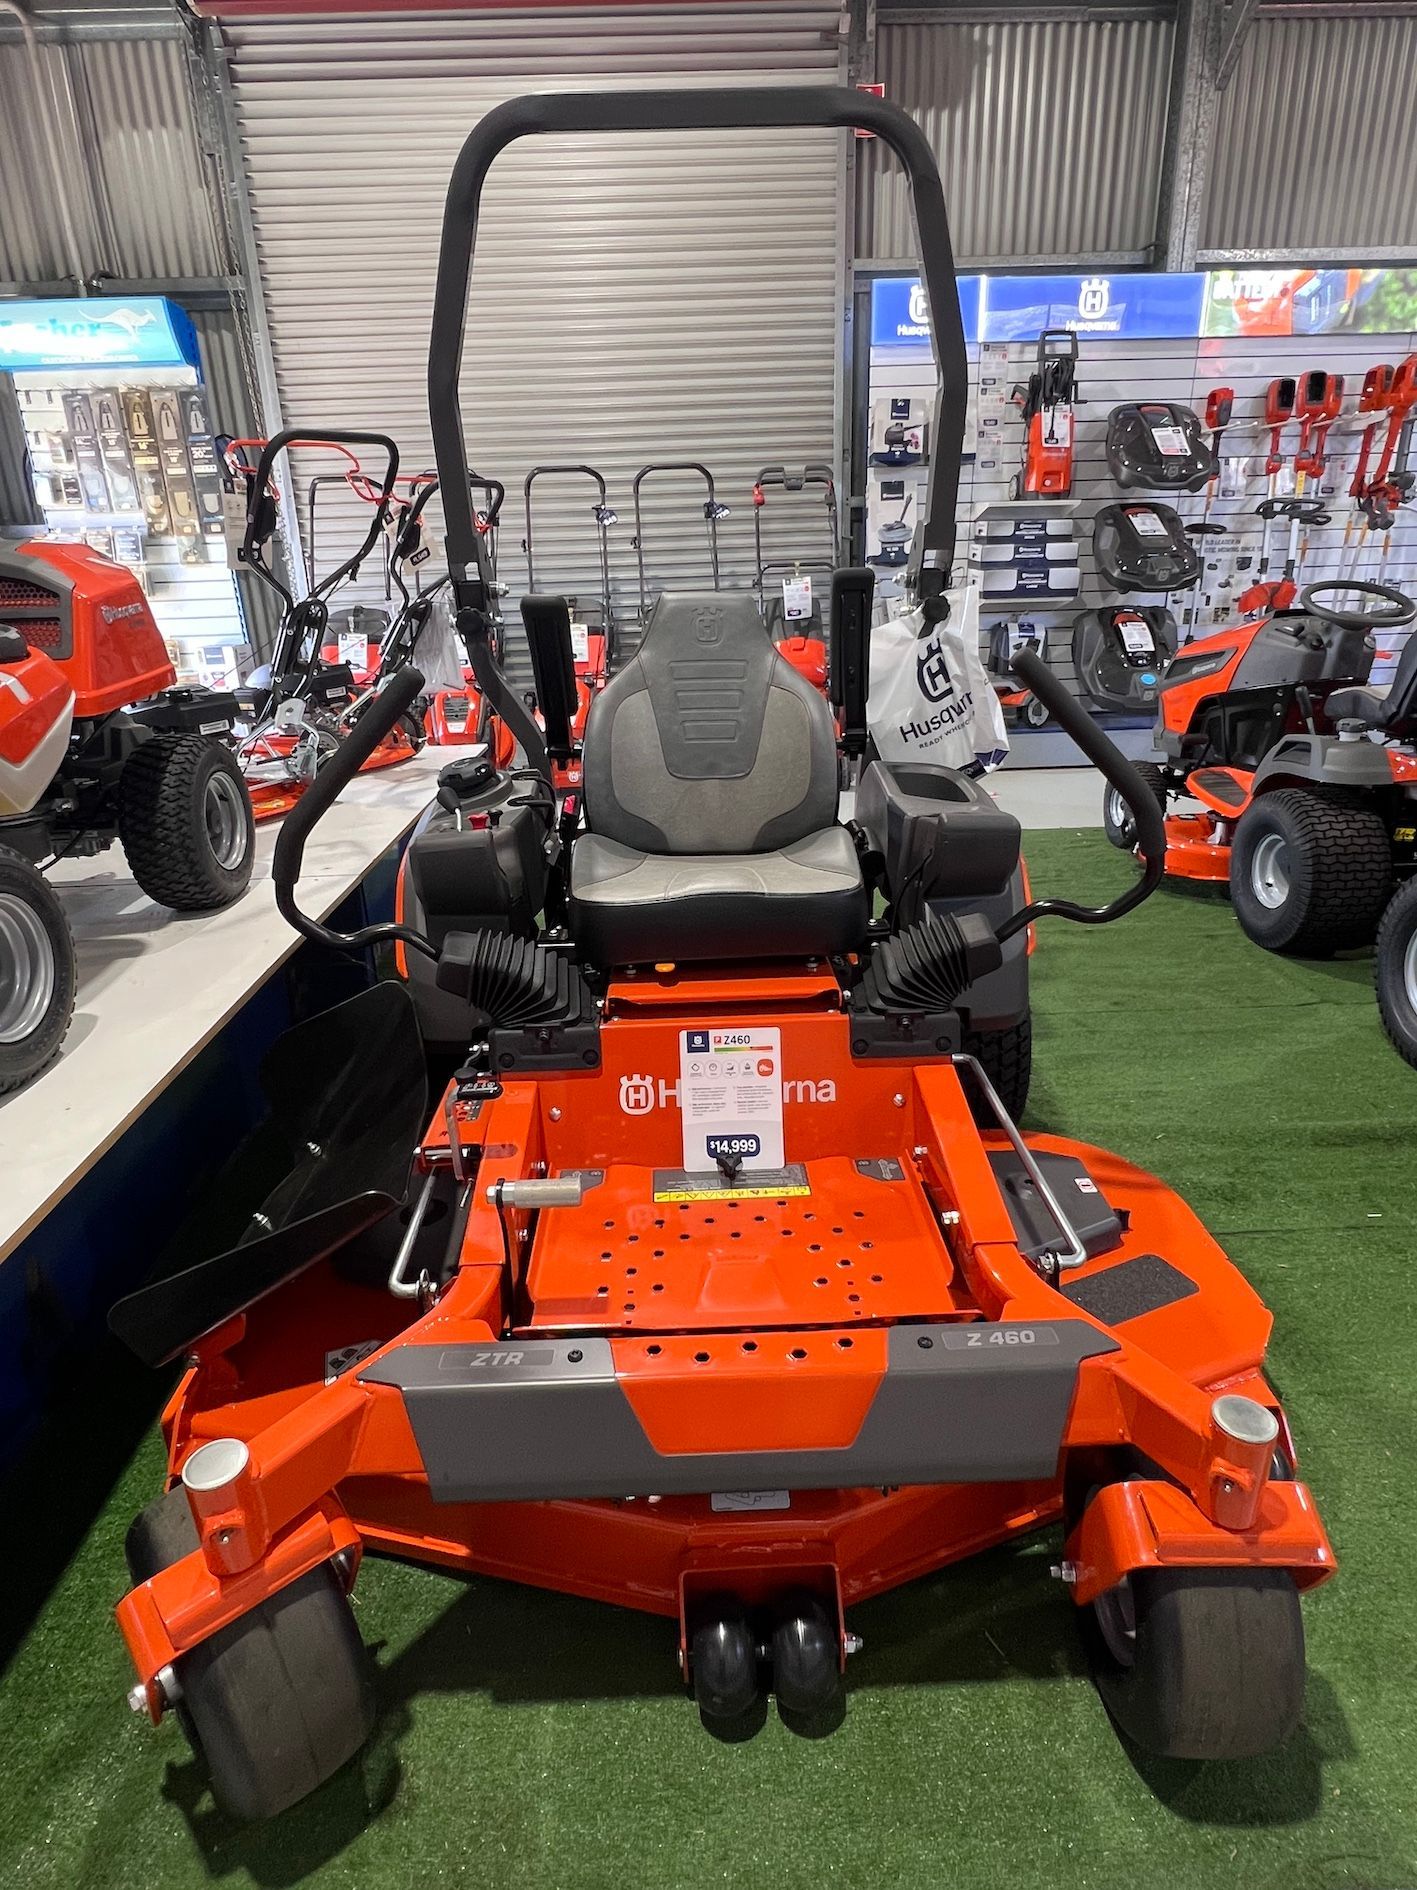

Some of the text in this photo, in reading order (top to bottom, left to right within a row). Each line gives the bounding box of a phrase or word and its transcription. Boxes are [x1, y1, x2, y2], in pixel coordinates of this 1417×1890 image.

[724, 1035, 751, 1045] Z460
[710, 1138, 757, 1154] $14,999
[966, 1330, 1036, 1346] Z 460
[470, 1351, 524, 1367] ZTR
